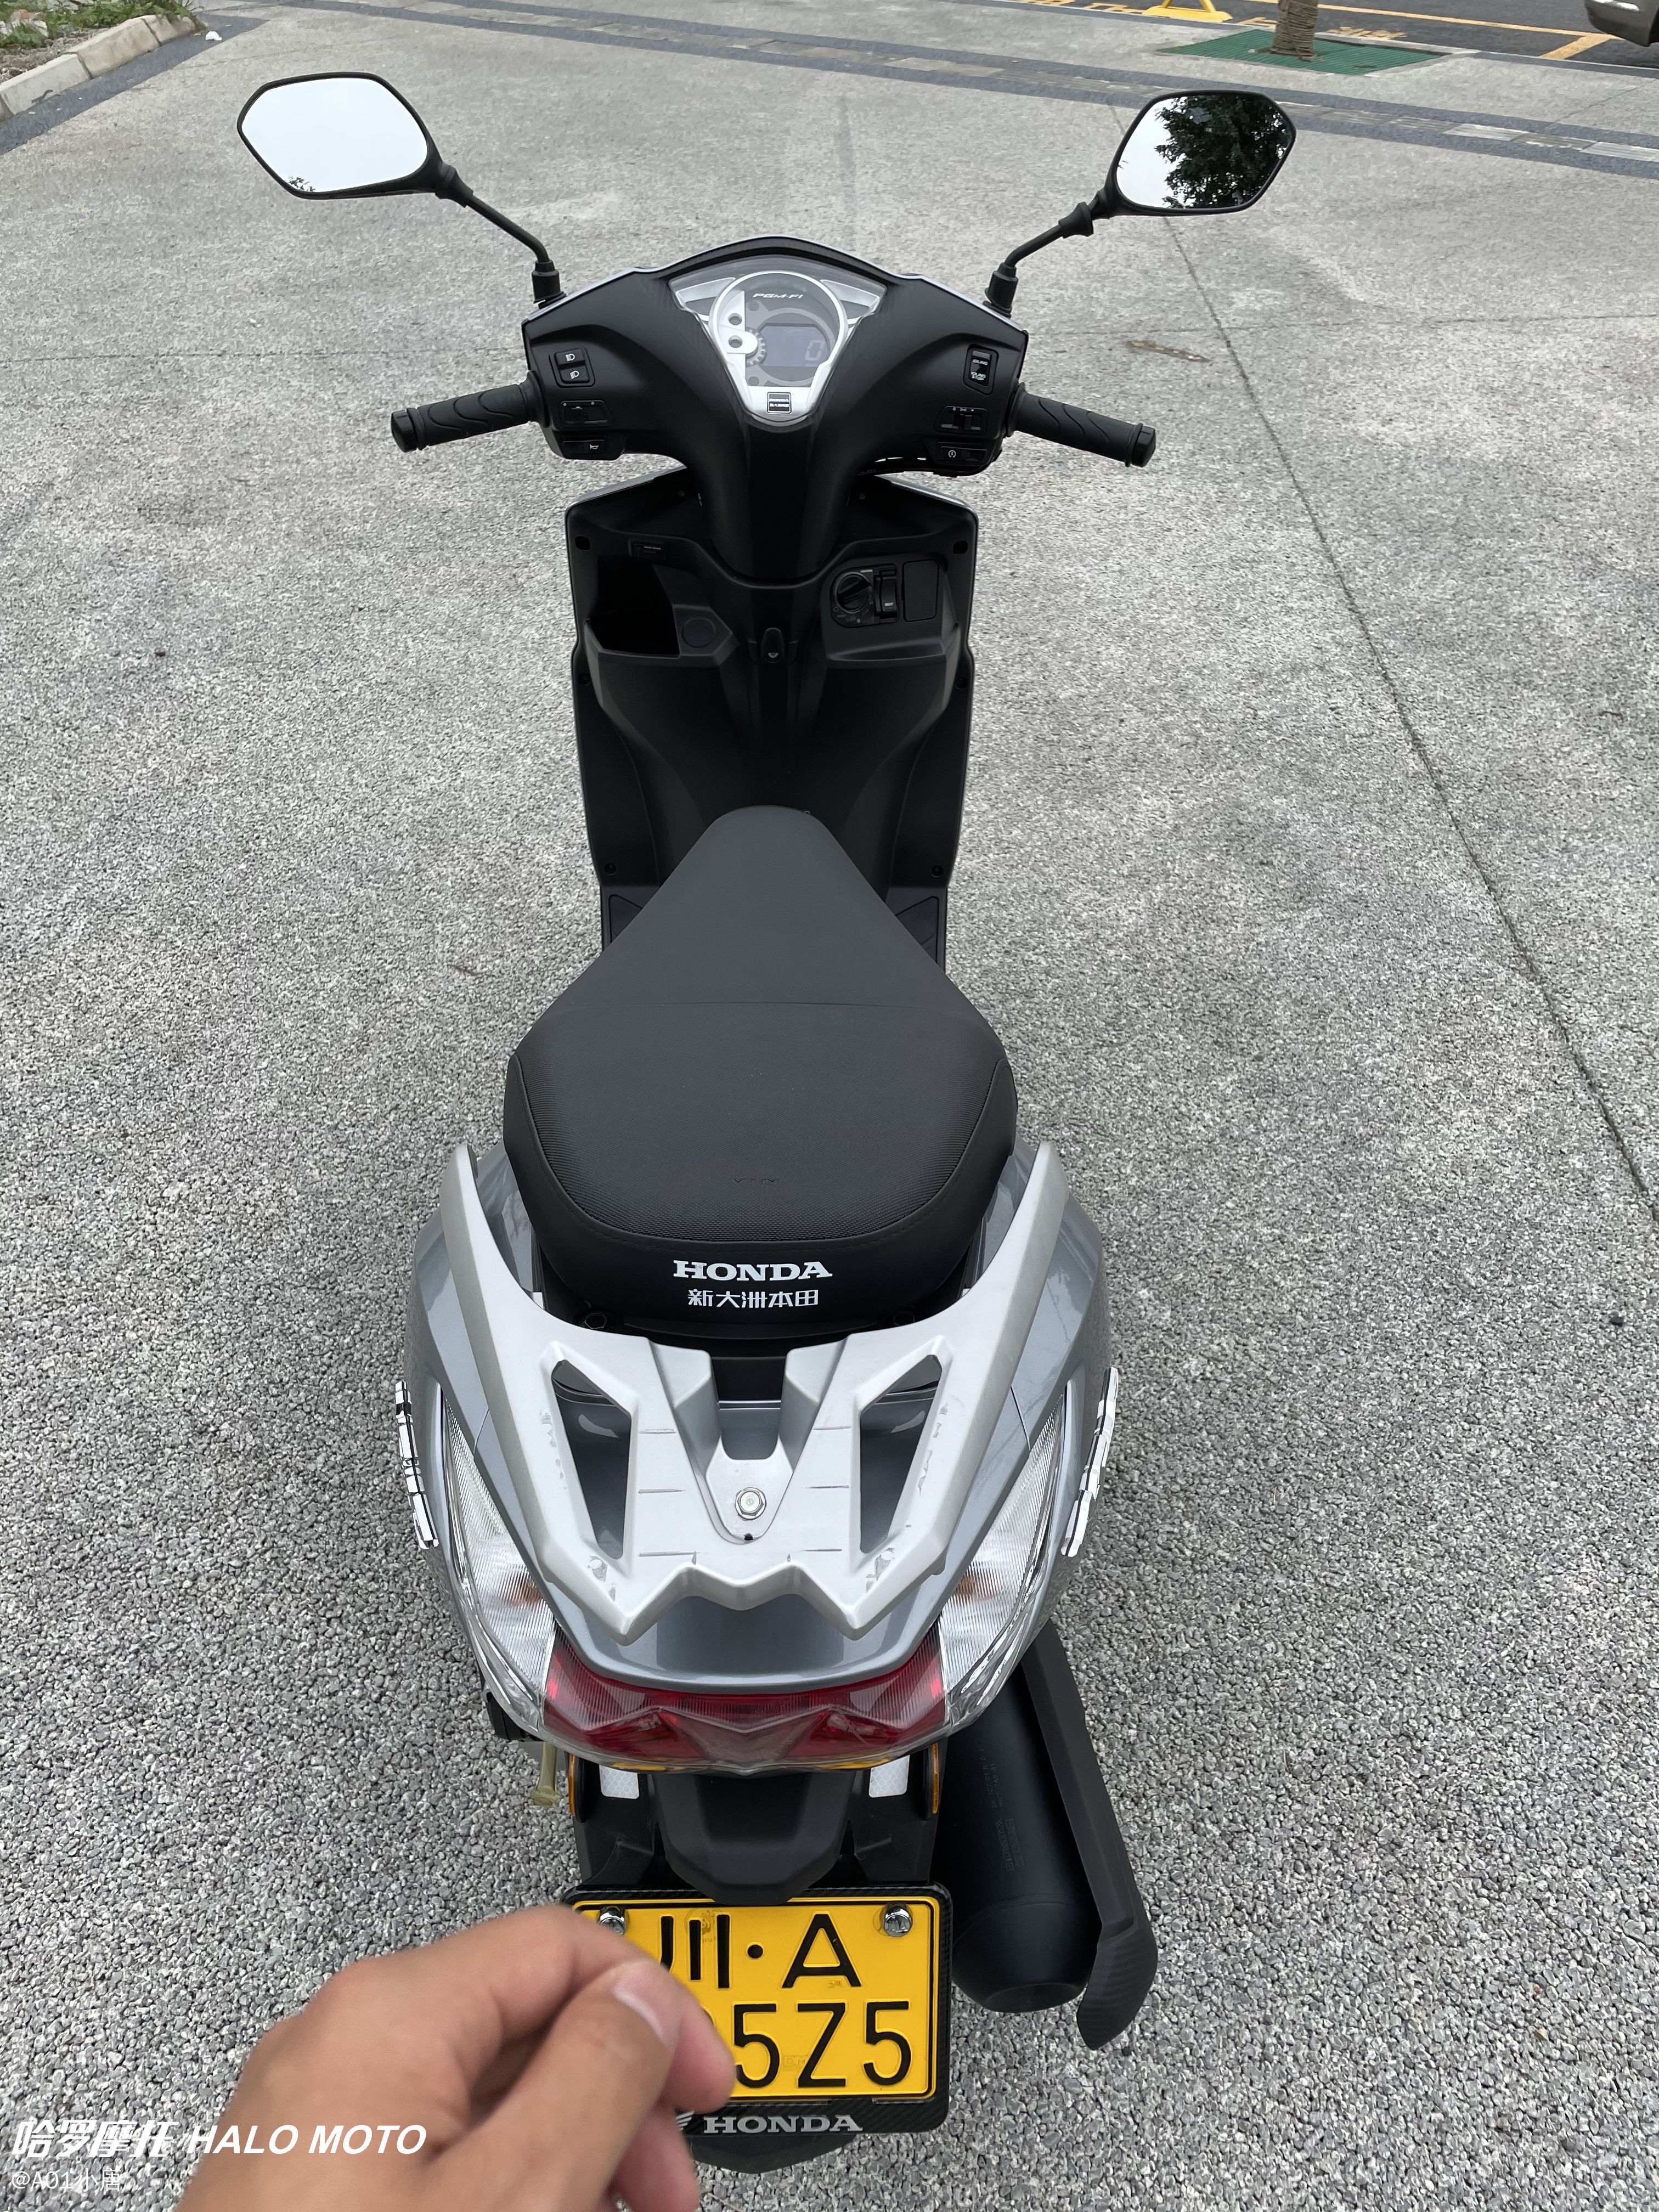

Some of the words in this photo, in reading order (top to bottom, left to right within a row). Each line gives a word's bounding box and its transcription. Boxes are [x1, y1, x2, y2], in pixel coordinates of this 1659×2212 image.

[805, 340, 825, 360] 0
[673, 1260, 833, 1280] HONDA
[687, 1289, 819, 1308] 新大洲本田
[701, 2001, 911, 2089] 5Z5
[704, 2115, 863, 2133] HONDA
